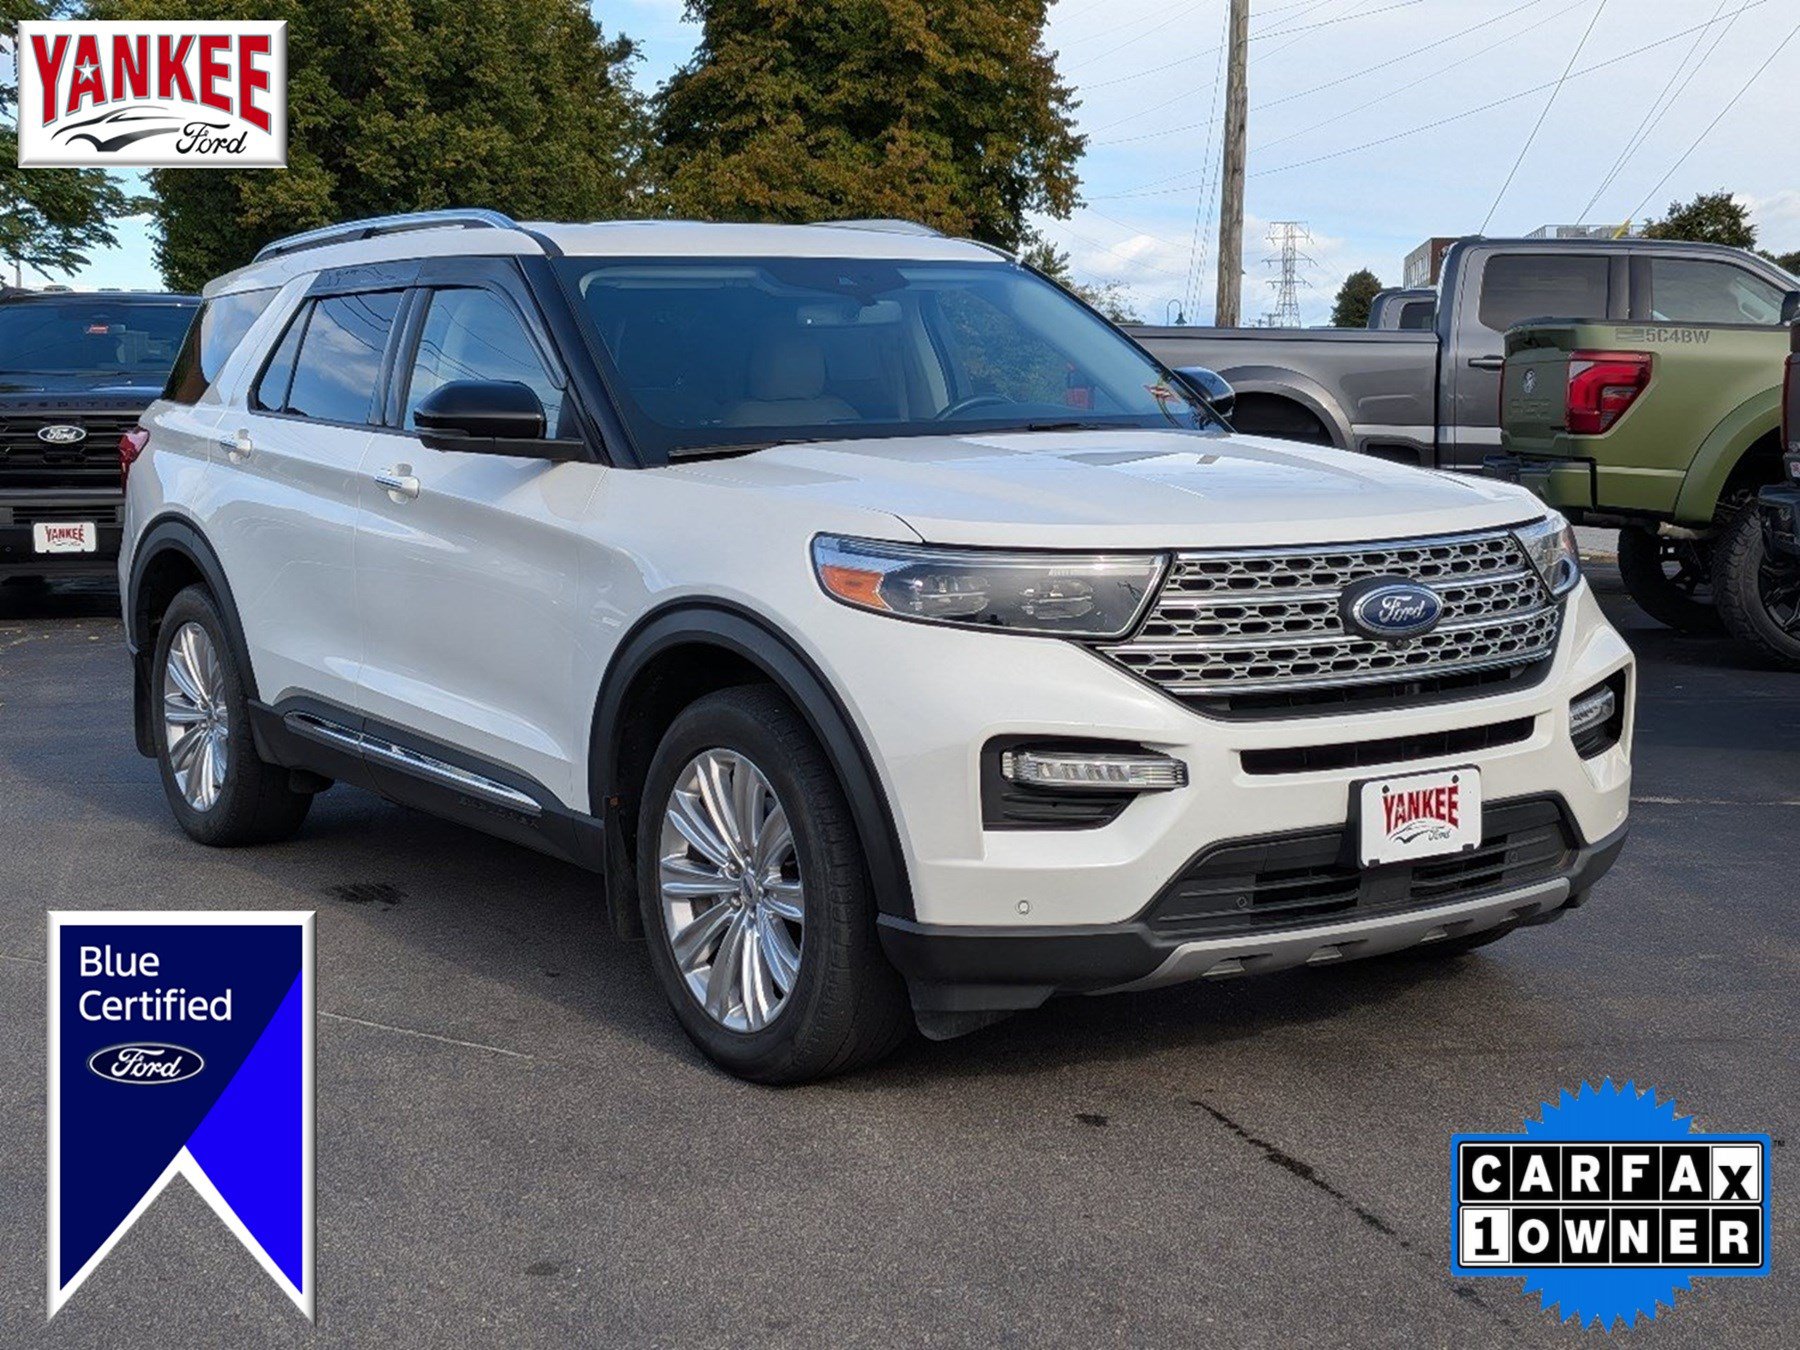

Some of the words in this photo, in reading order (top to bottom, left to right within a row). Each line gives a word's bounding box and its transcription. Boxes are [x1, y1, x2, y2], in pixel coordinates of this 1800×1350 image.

[46, 426, 77, 441] Ford
[45, 526, 85, 543] YANKEE
[1379, 595, 1426, 623] Ford
[1382, 785, 1459, 837] YANKEE
